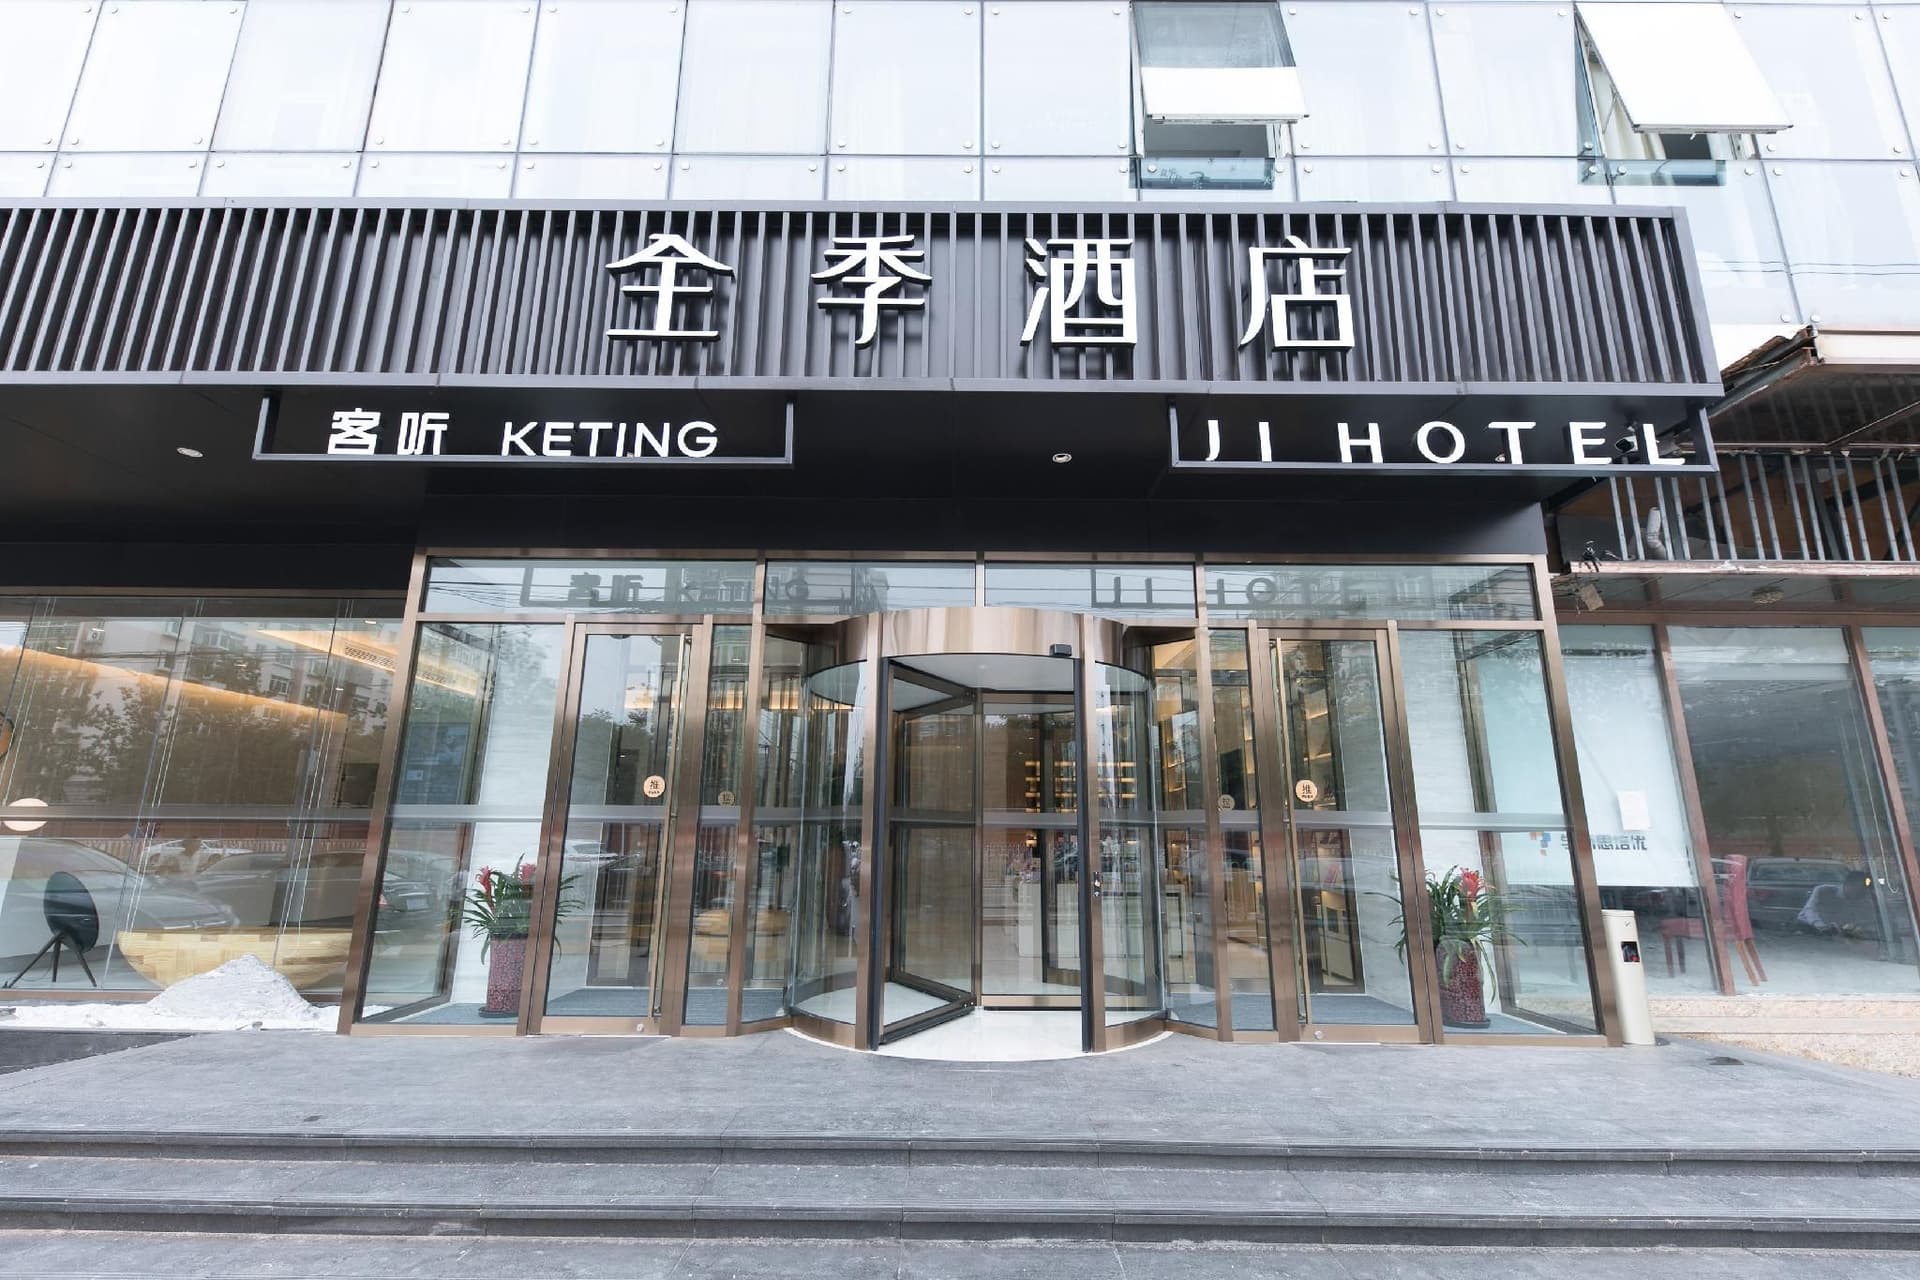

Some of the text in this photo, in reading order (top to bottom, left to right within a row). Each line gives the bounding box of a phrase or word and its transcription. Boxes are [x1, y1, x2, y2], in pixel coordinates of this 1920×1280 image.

[606, 233, 1357, 348] 全季酒店
[327, 408, 718, 459] 客听 KETING
[1205, 419, 1686, 467] JI HOTEL
